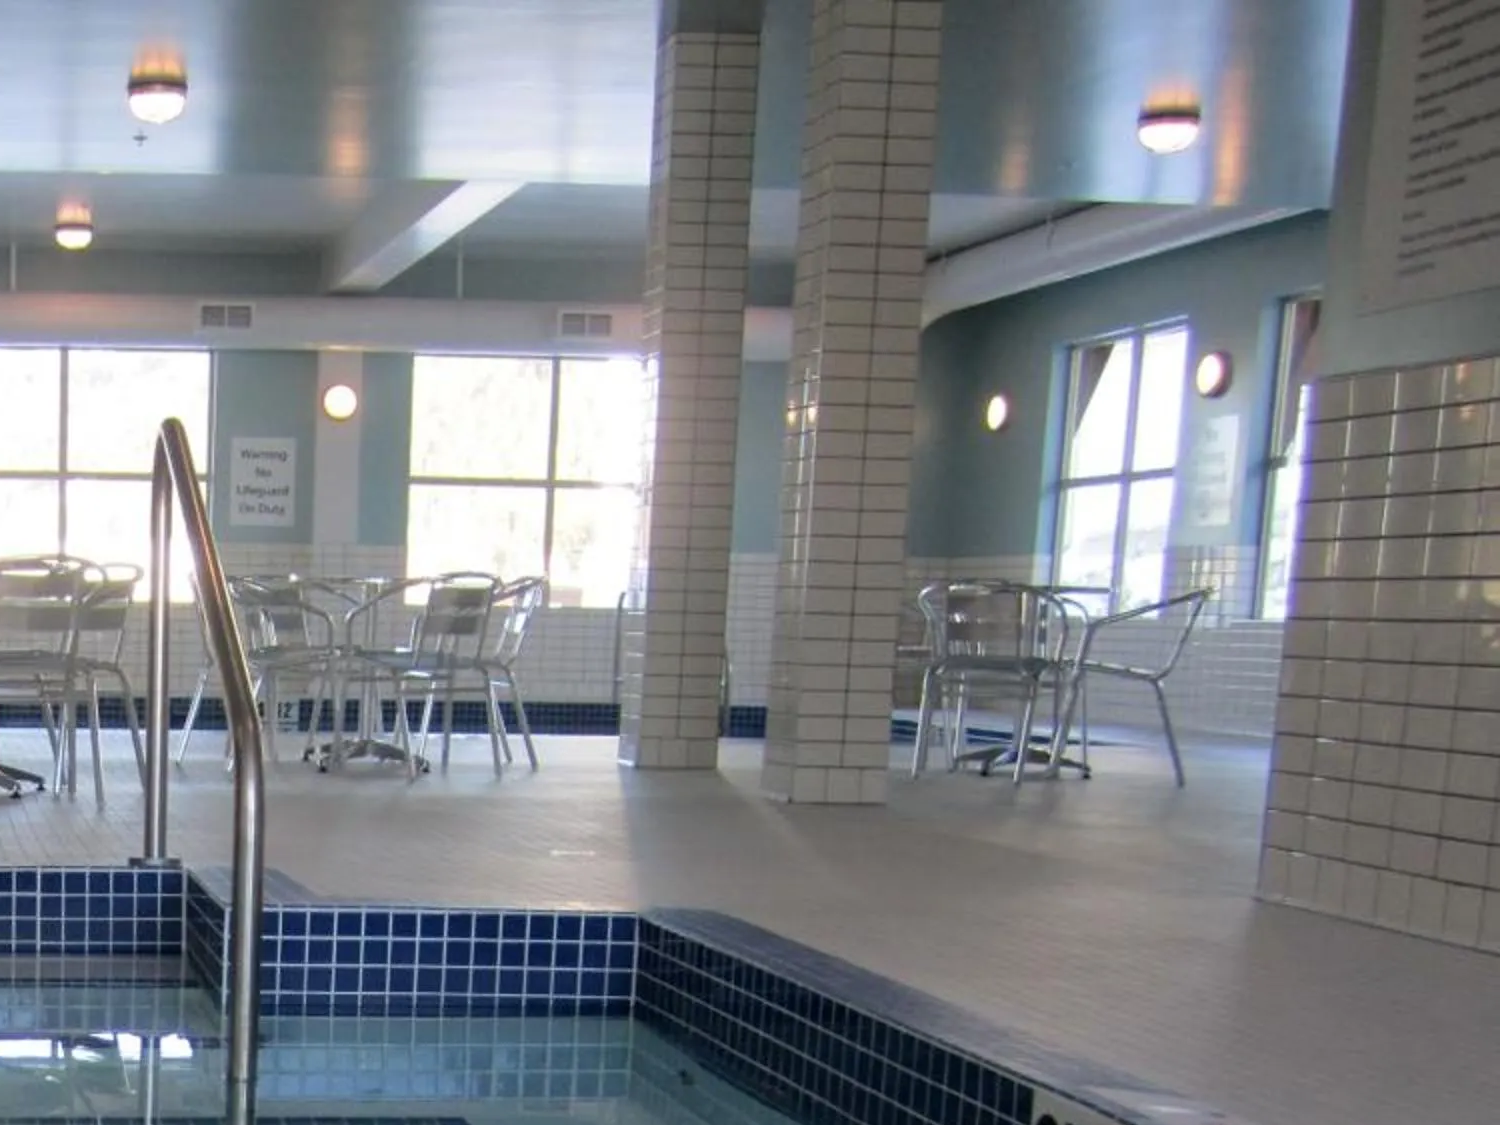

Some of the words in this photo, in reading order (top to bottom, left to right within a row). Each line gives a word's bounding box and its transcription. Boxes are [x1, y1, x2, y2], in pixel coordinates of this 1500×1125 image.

[241, 449, 287, 462] Warning
[255, 466, 272, 477] No
[236, 485, 289, 498] Lifeguard
[258, 502, 285, 516] Duty
